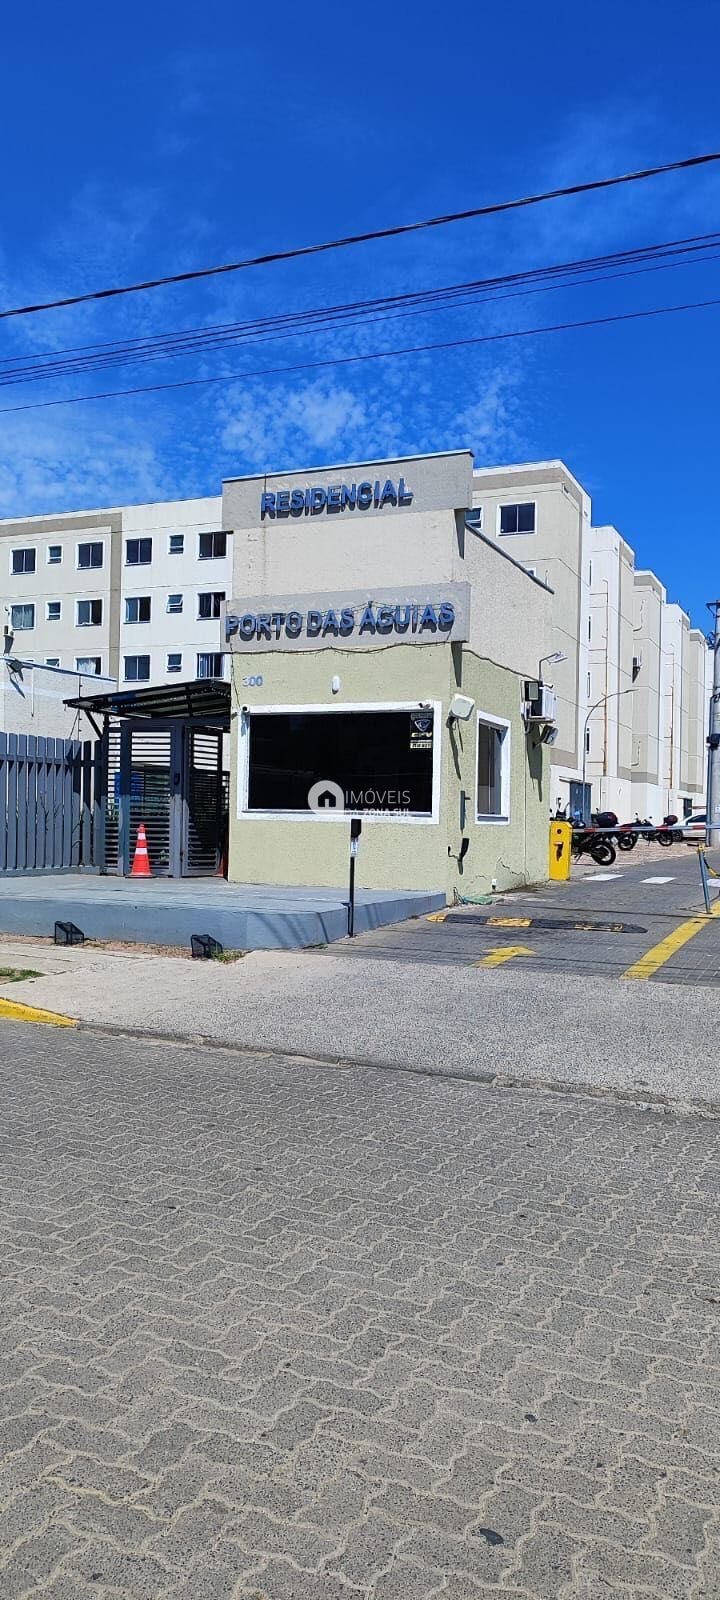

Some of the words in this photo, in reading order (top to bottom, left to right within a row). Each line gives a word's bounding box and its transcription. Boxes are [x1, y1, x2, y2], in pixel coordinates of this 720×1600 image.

[260, 478, 413, 513] RESIDENCIAL
[225, 611, 303, 638] PORTO
[306, 608, 354, 634] DAS
